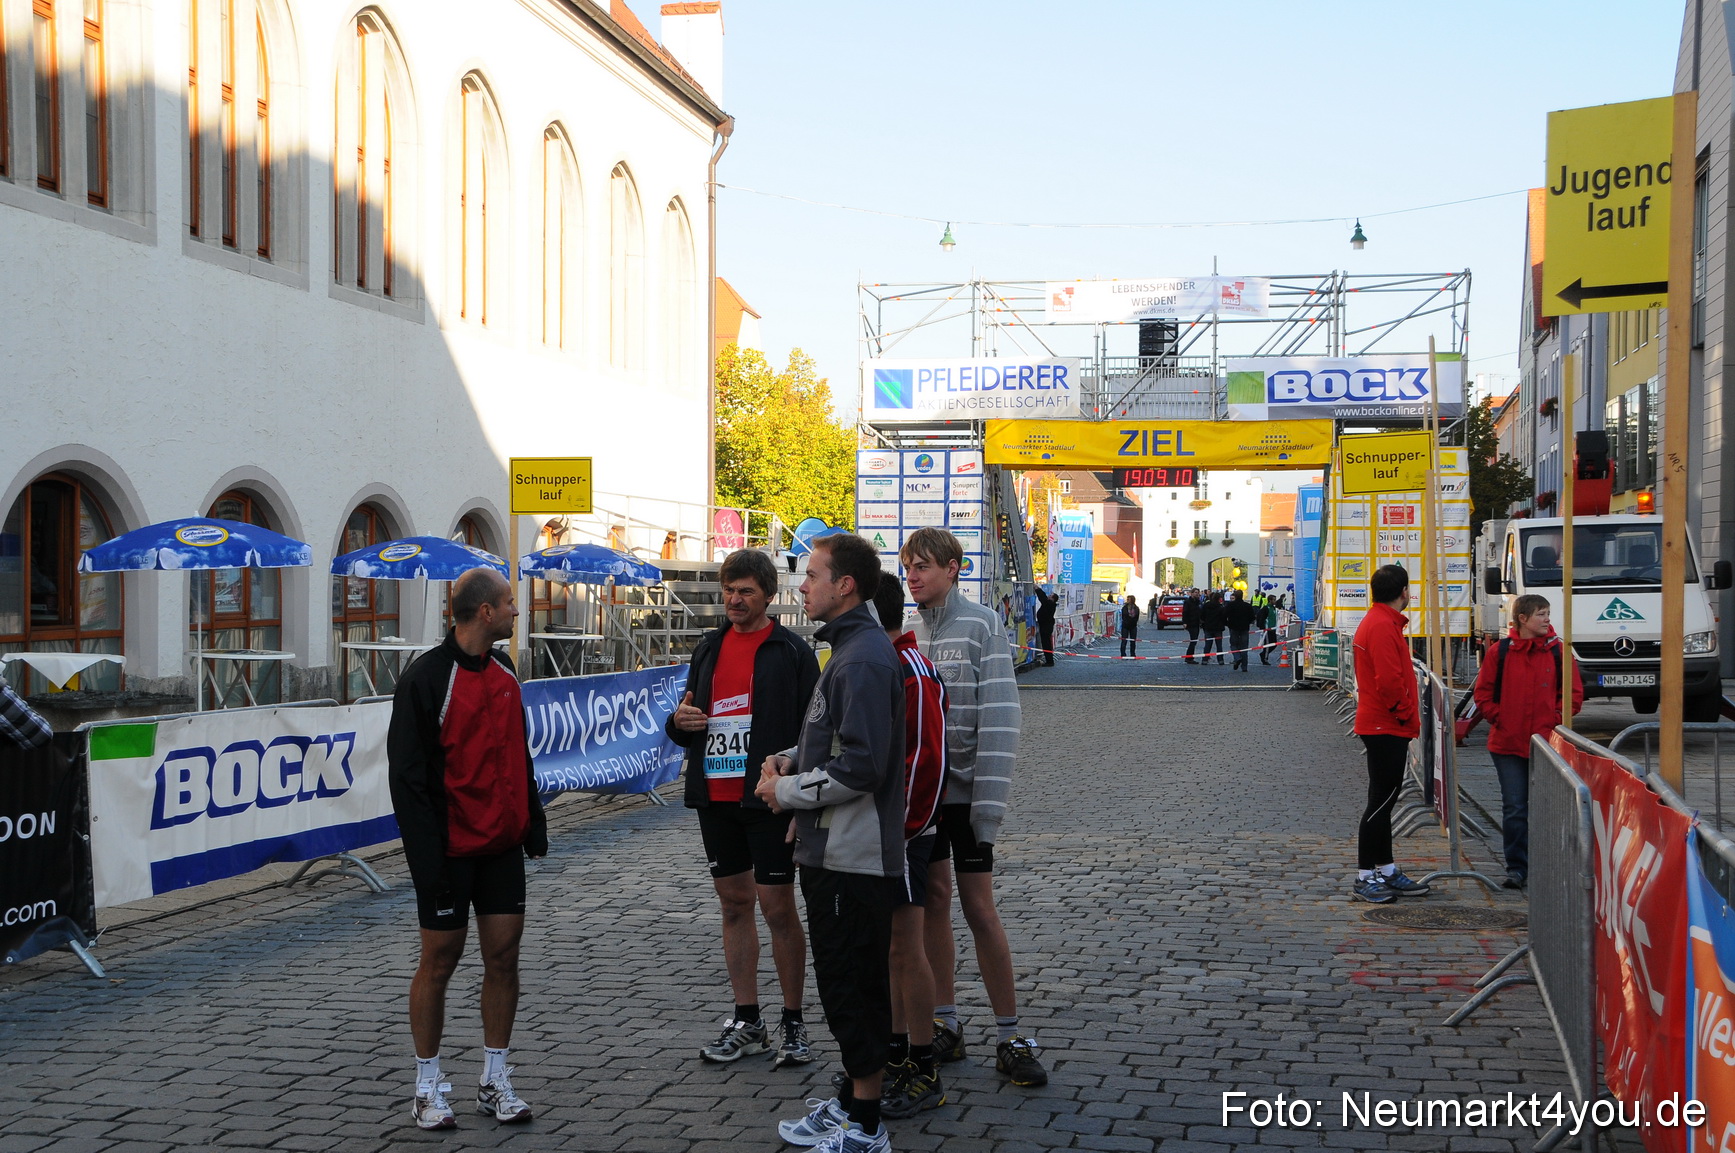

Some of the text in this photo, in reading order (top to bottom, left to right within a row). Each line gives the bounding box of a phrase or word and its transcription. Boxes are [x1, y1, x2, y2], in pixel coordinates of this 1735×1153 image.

[1550, 154, 1673, 199] Jugend
[1587, 196, 1651, 232] lauf
[1111, 281, 1195, 294] LEBENSSPENDER
[1131, 295, 1177, 306] WERDEN!
[1133, 307, 1176, 316] www.dkms.de
[917, 364, 1070, 393] PFLEIDERER
[1267, 367, 1429, 403] BOCK
[917, 395, 1070, 410] AKTIENGESELLSCHAFT
[1334, 405, 1431, 417] www.bockonline.de
[1002, 443, 1042, 451] Neumarkter
[1117, 429, 1195, 457] ZIEL
[1346, 451, 1426, 464] Schnupper-
[1373, 466, 1399, 479] lauf
[515, 474, 586, 487] Schnupper-
[906, 483, 930, 492] MCM
[540, 489, 562, 500] lauf
[1379, 532, 1417, 542] Sinupet
[937, 649, 963, 660] 1974
[1603, 675, 1655, 684] NM PJ 145
[721, 699, 739, 709] DEHN
[526, 687, 660, 759] universa
[150, 731, 356, 831] BOCK
